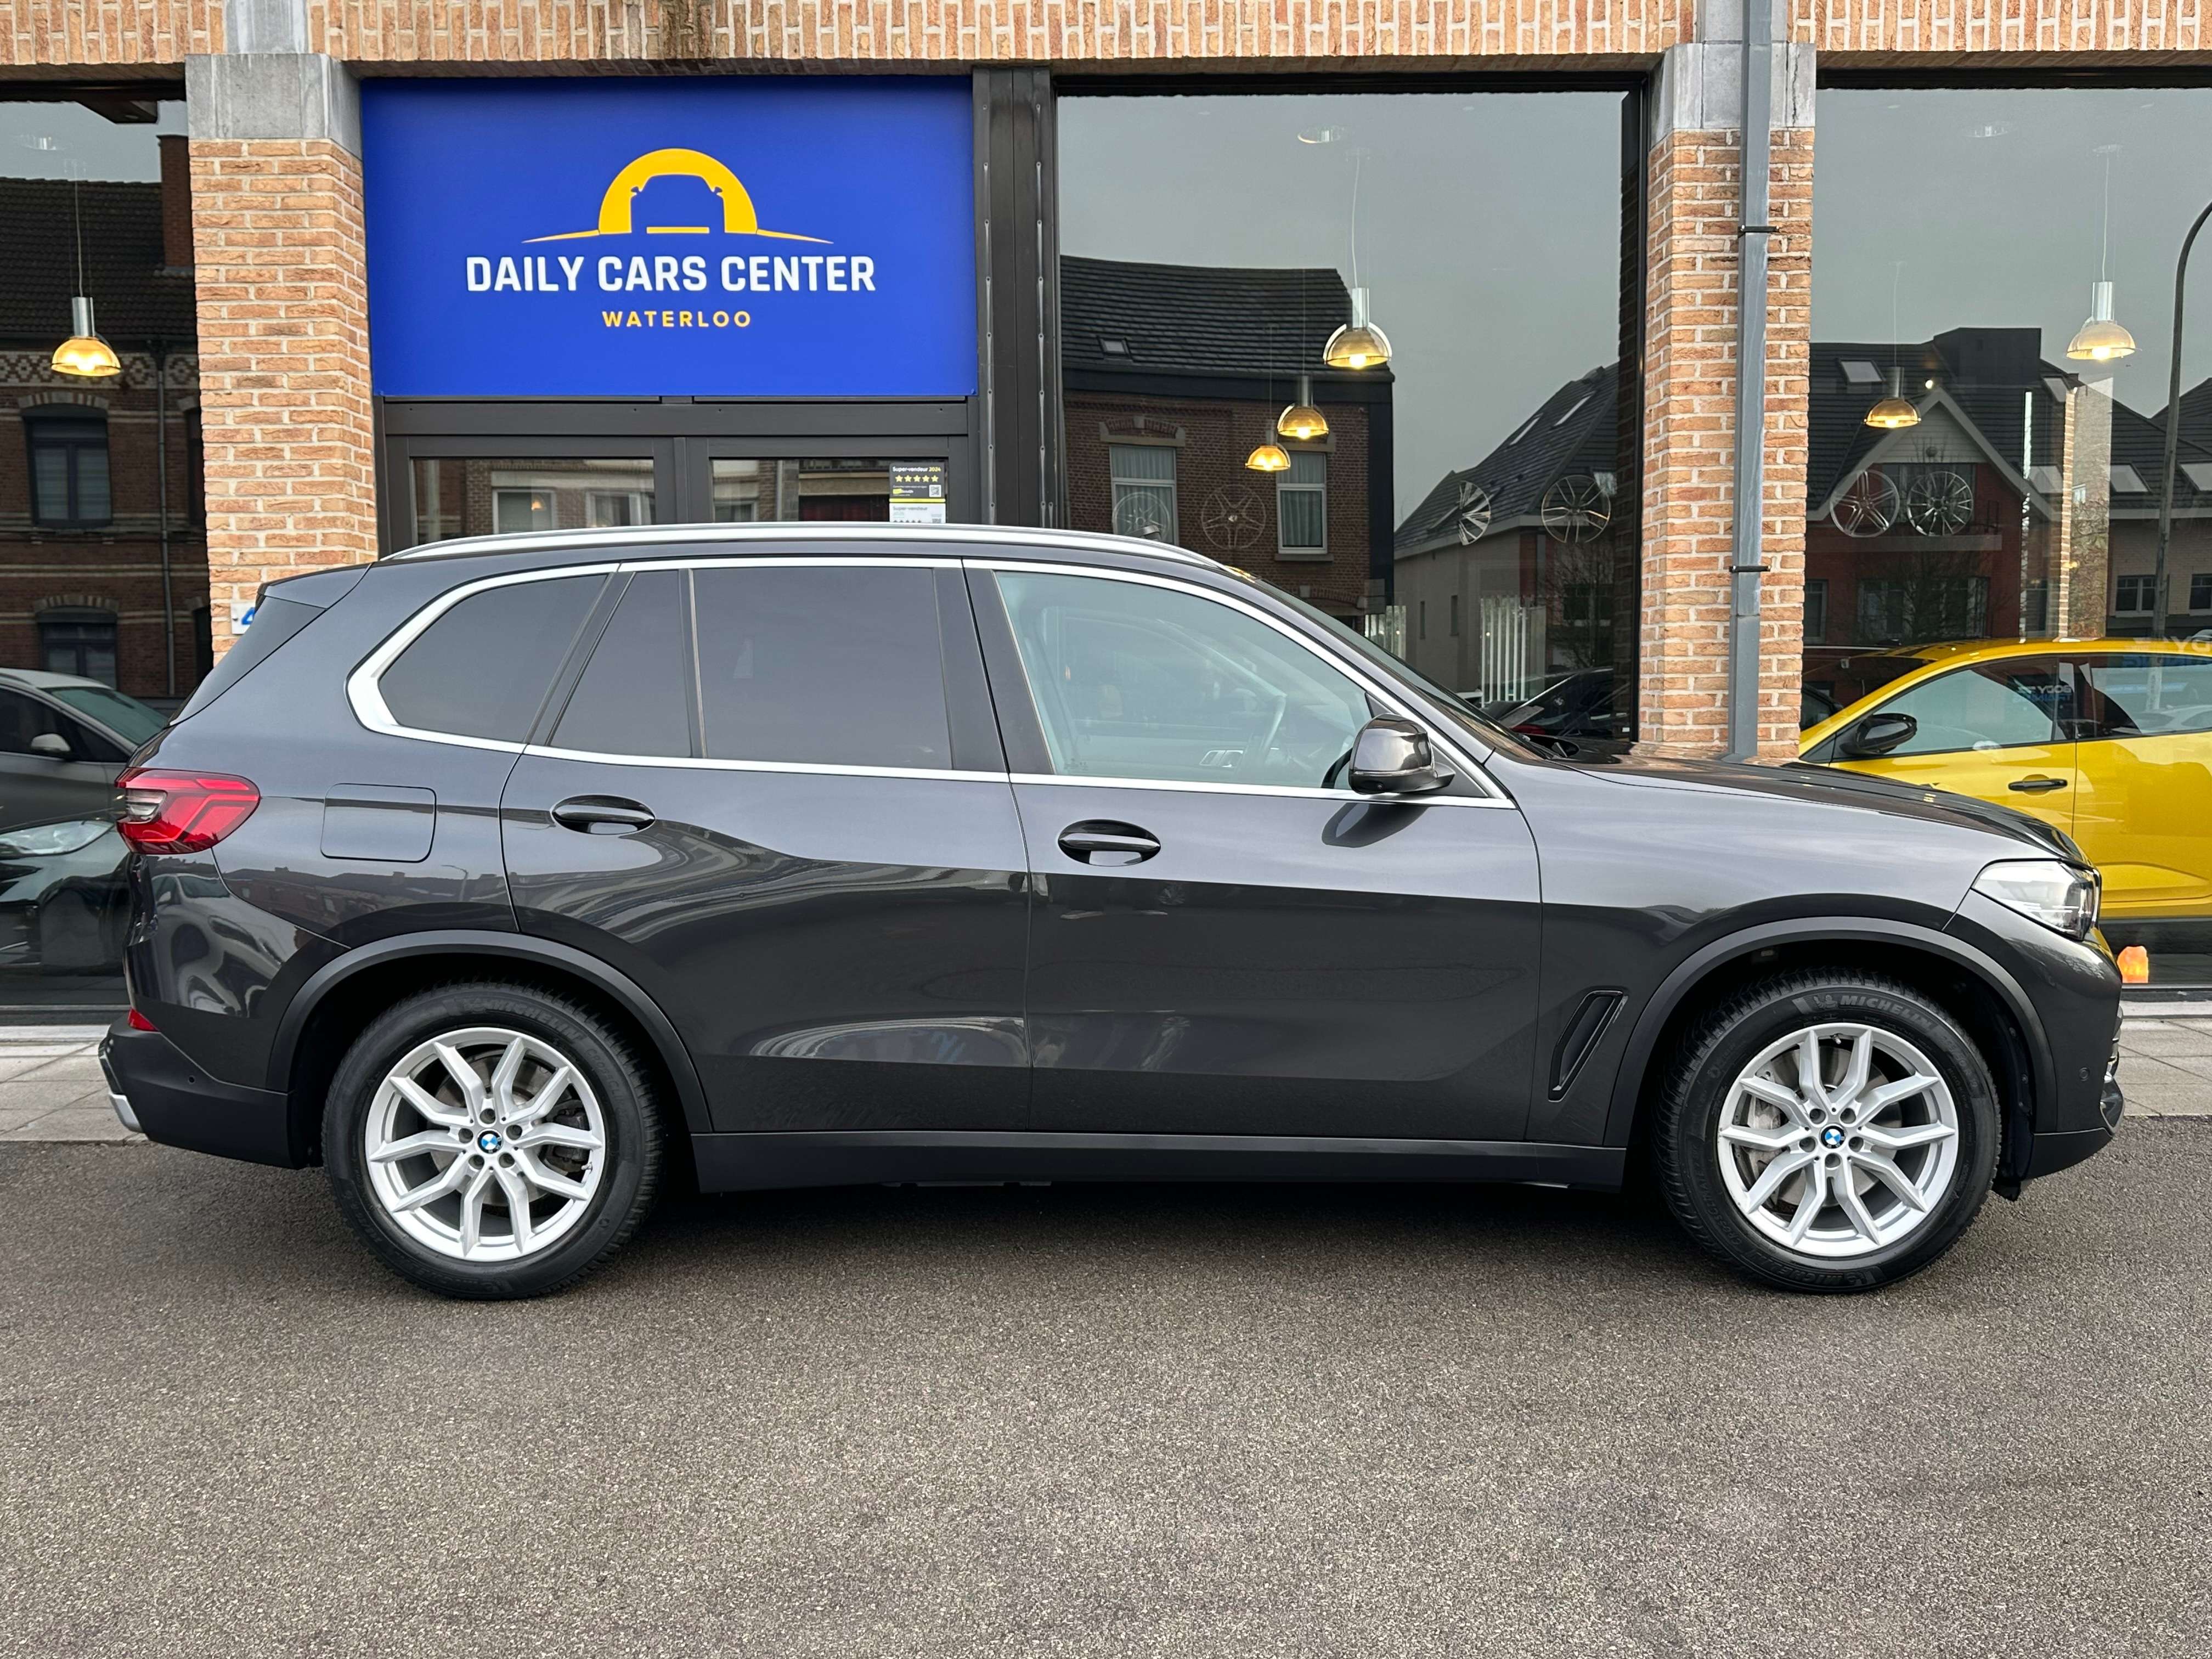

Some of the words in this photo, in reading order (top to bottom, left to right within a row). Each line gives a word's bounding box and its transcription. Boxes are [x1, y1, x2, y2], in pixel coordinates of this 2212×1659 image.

[466, 256, 584, 292] DAILY
[598, 256, 707, 292] CARS
[721, 256, 876, 291] CENTER
[602, 311, 751, 328] WATERLOO
[1840, 995, 1936, 1032] MICHELIN
